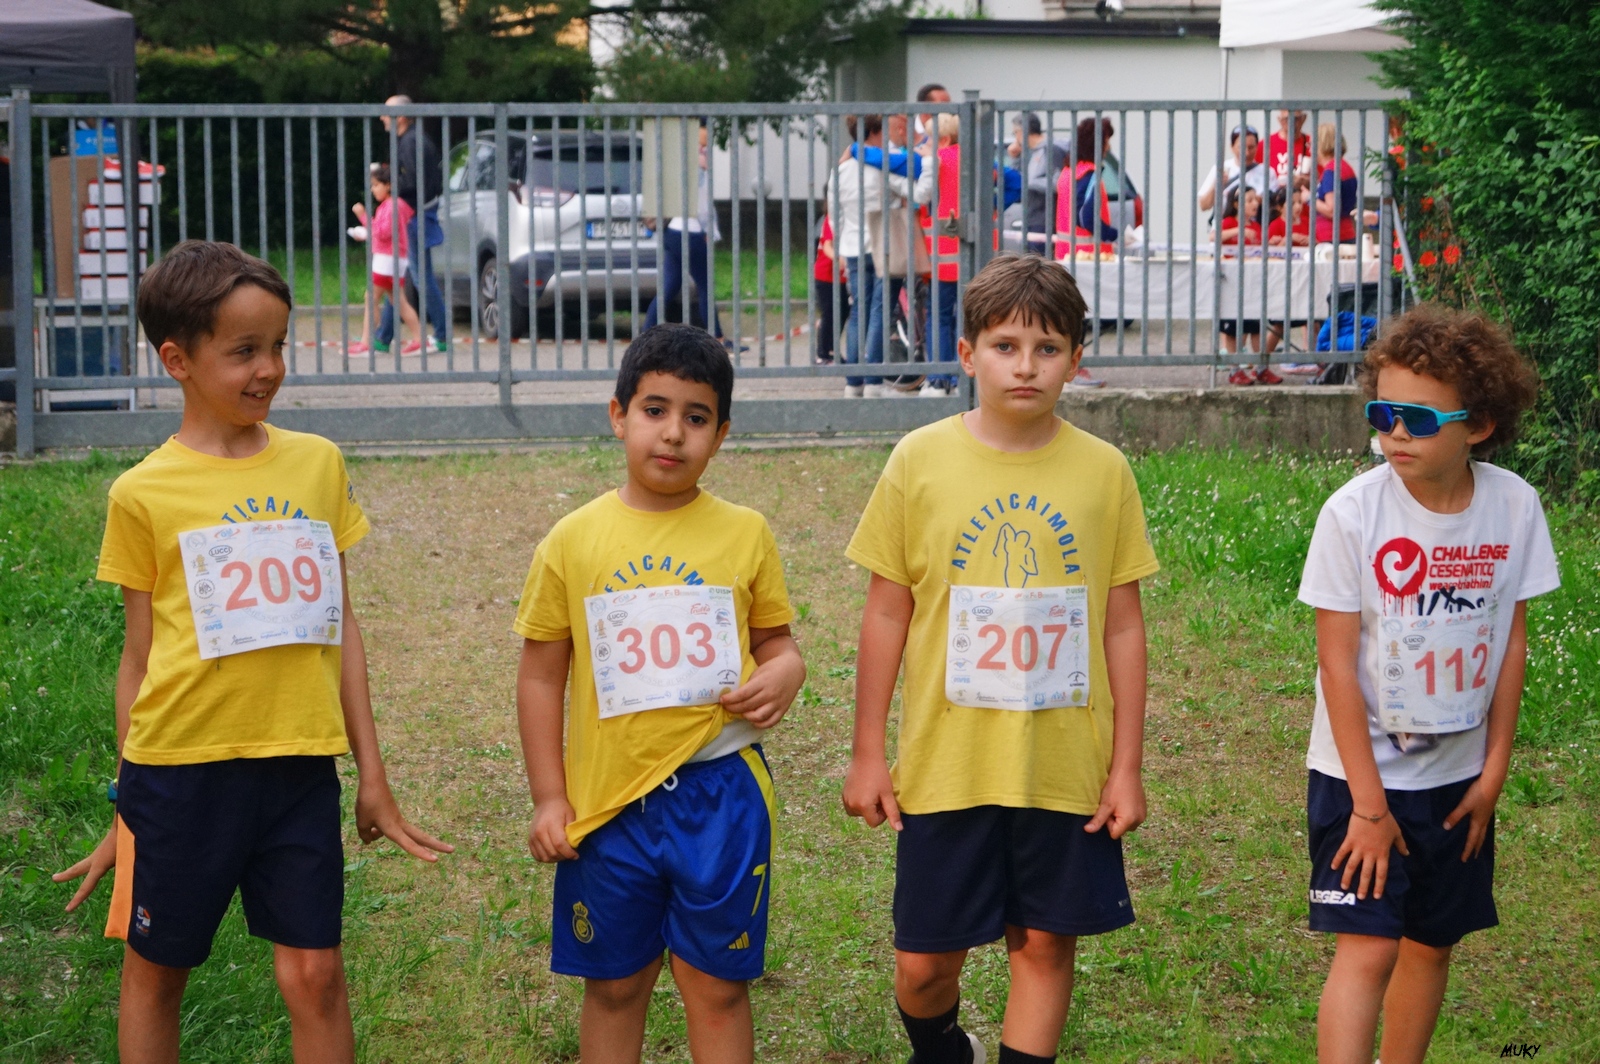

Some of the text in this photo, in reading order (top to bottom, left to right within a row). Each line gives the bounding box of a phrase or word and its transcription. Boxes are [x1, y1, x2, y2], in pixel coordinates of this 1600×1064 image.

[210, 547, 232, 555] LUCCI
[1432, 544, 1510, 561] CHALLENGE
[1429, 562, 1495, 578] CESENATICO
[220, 555, 322, 612] 209
[608, 611, 627, 620] LUCCI
[616, 622, 716, 674] 303
[976, 624, 1067, 672] 207
[1404, 636, 1424, 644] LUCCI
[1415, 643, 1488, 696] 112
[752, 862, 768, 917] 7
[1310, 889, 1356, 906] LEGEA
